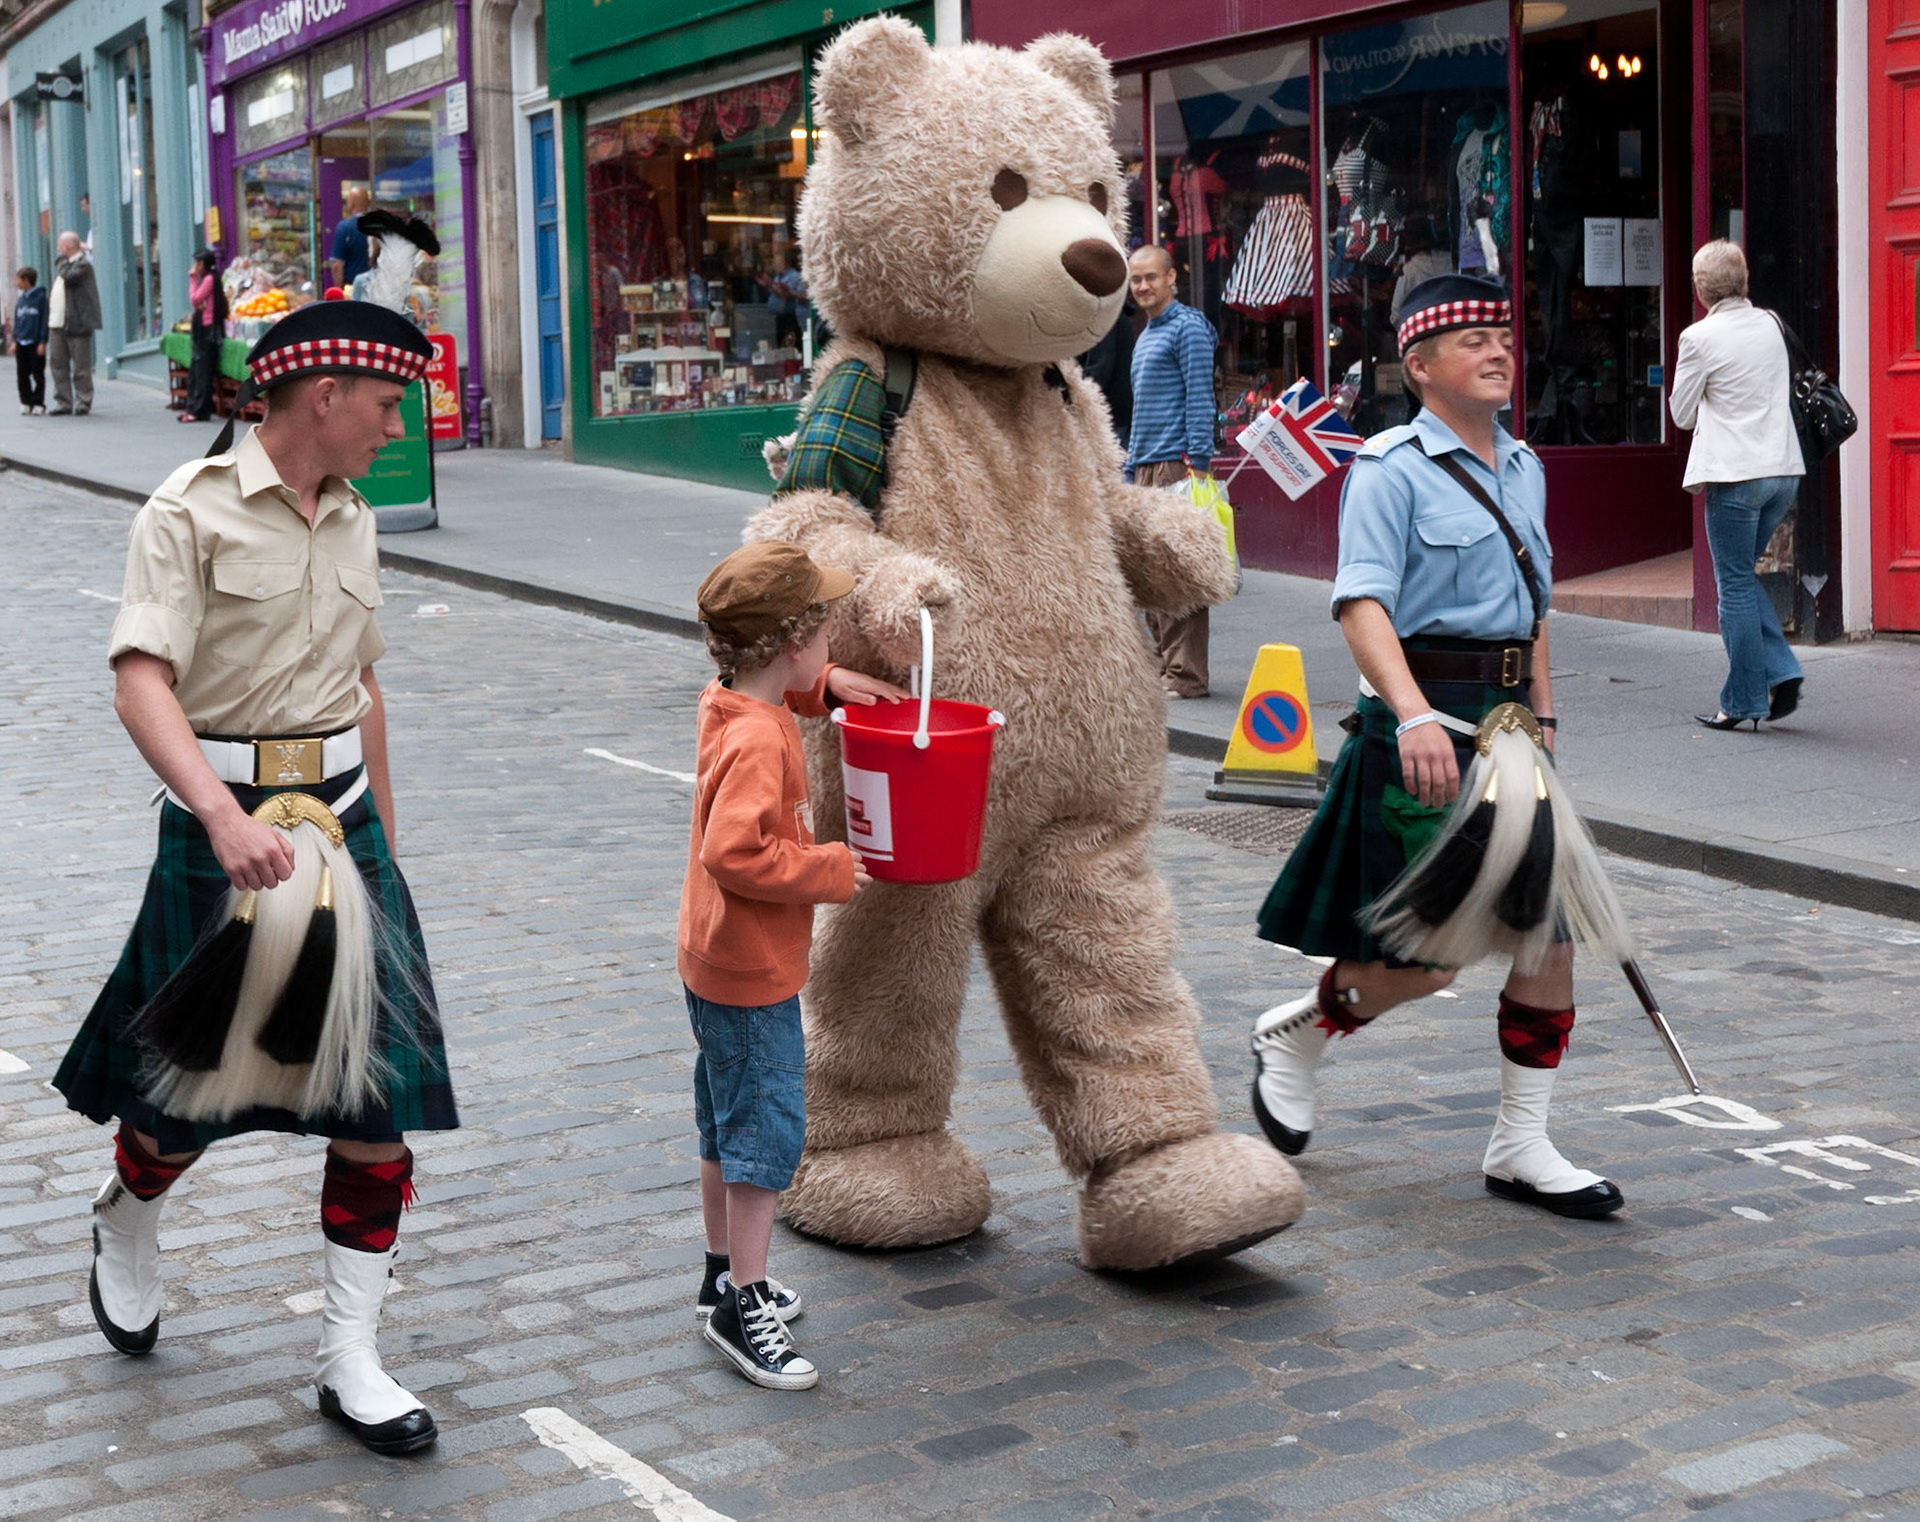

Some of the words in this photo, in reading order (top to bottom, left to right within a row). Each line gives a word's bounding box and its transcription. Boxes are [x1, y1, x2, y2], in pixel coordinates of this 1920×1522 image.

[223, 24, 262, 64] Mama
[260, 2, 291, 46] Said
[1268, 430, 1298, 465] FORCES
[1295, 463, 1312, 479] DAY
